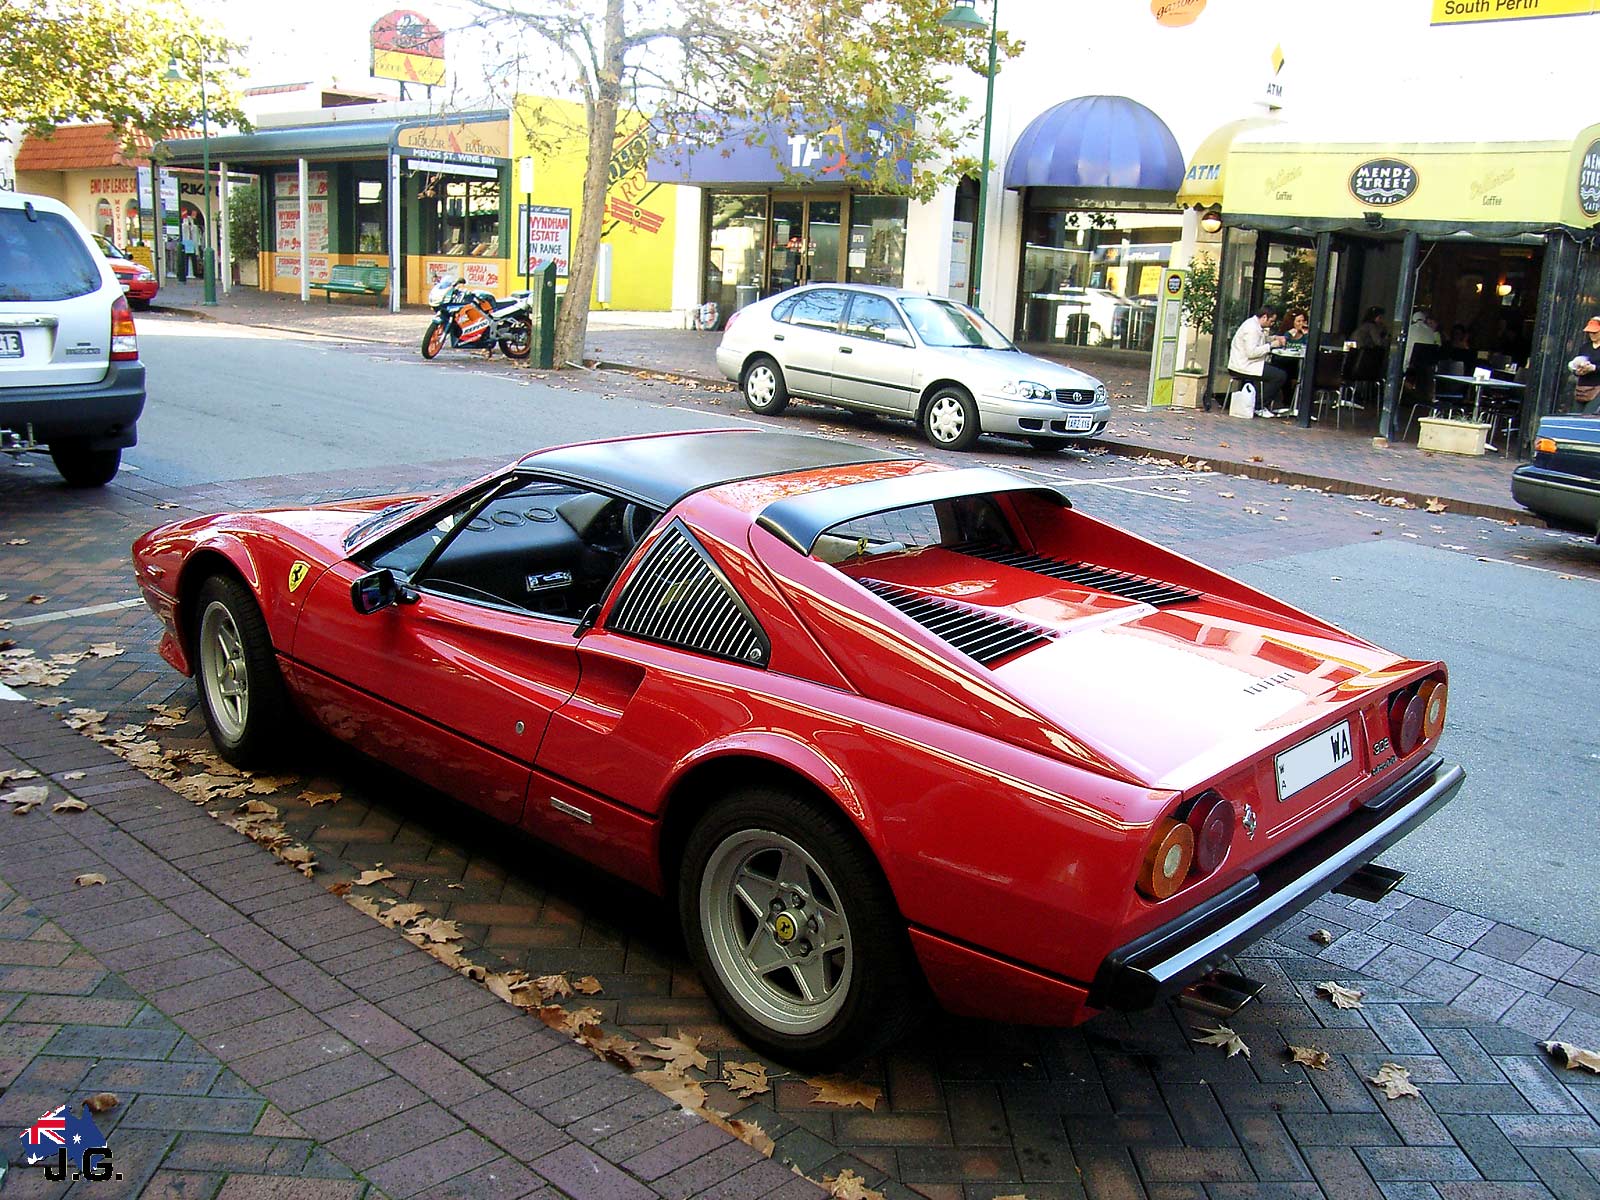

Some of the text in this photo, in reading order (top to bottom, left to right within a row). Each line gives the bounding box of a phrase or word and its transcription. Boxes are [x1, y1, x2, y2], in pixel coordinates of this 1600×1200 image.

[1444, 0, 1538, 15] South Perth
[1267, 83, 1282, 97] ATM
[408, 135, 501, 155] LIQUOR BARONS
[413, 148, 495, 165] MENDS ST. WINE BIN
[1186, 164, 1221, 180] ATM
[1357, 167, 1411, 178] MENDS
[90, 179, 101, 194] END
[103, 179, 110, 193] OF
[111, 178, 128, 194] LEASE
[1355, 177, 1411, 189] STREET
[1276, 191, 1292, 200] Coffee
[1482, 195, 1502, 206] Coffee
[531, 230, 560, 242] ESTATE
[540, 243, 562, 255] RANGE
[1330, 729, 1350, 763] WA
